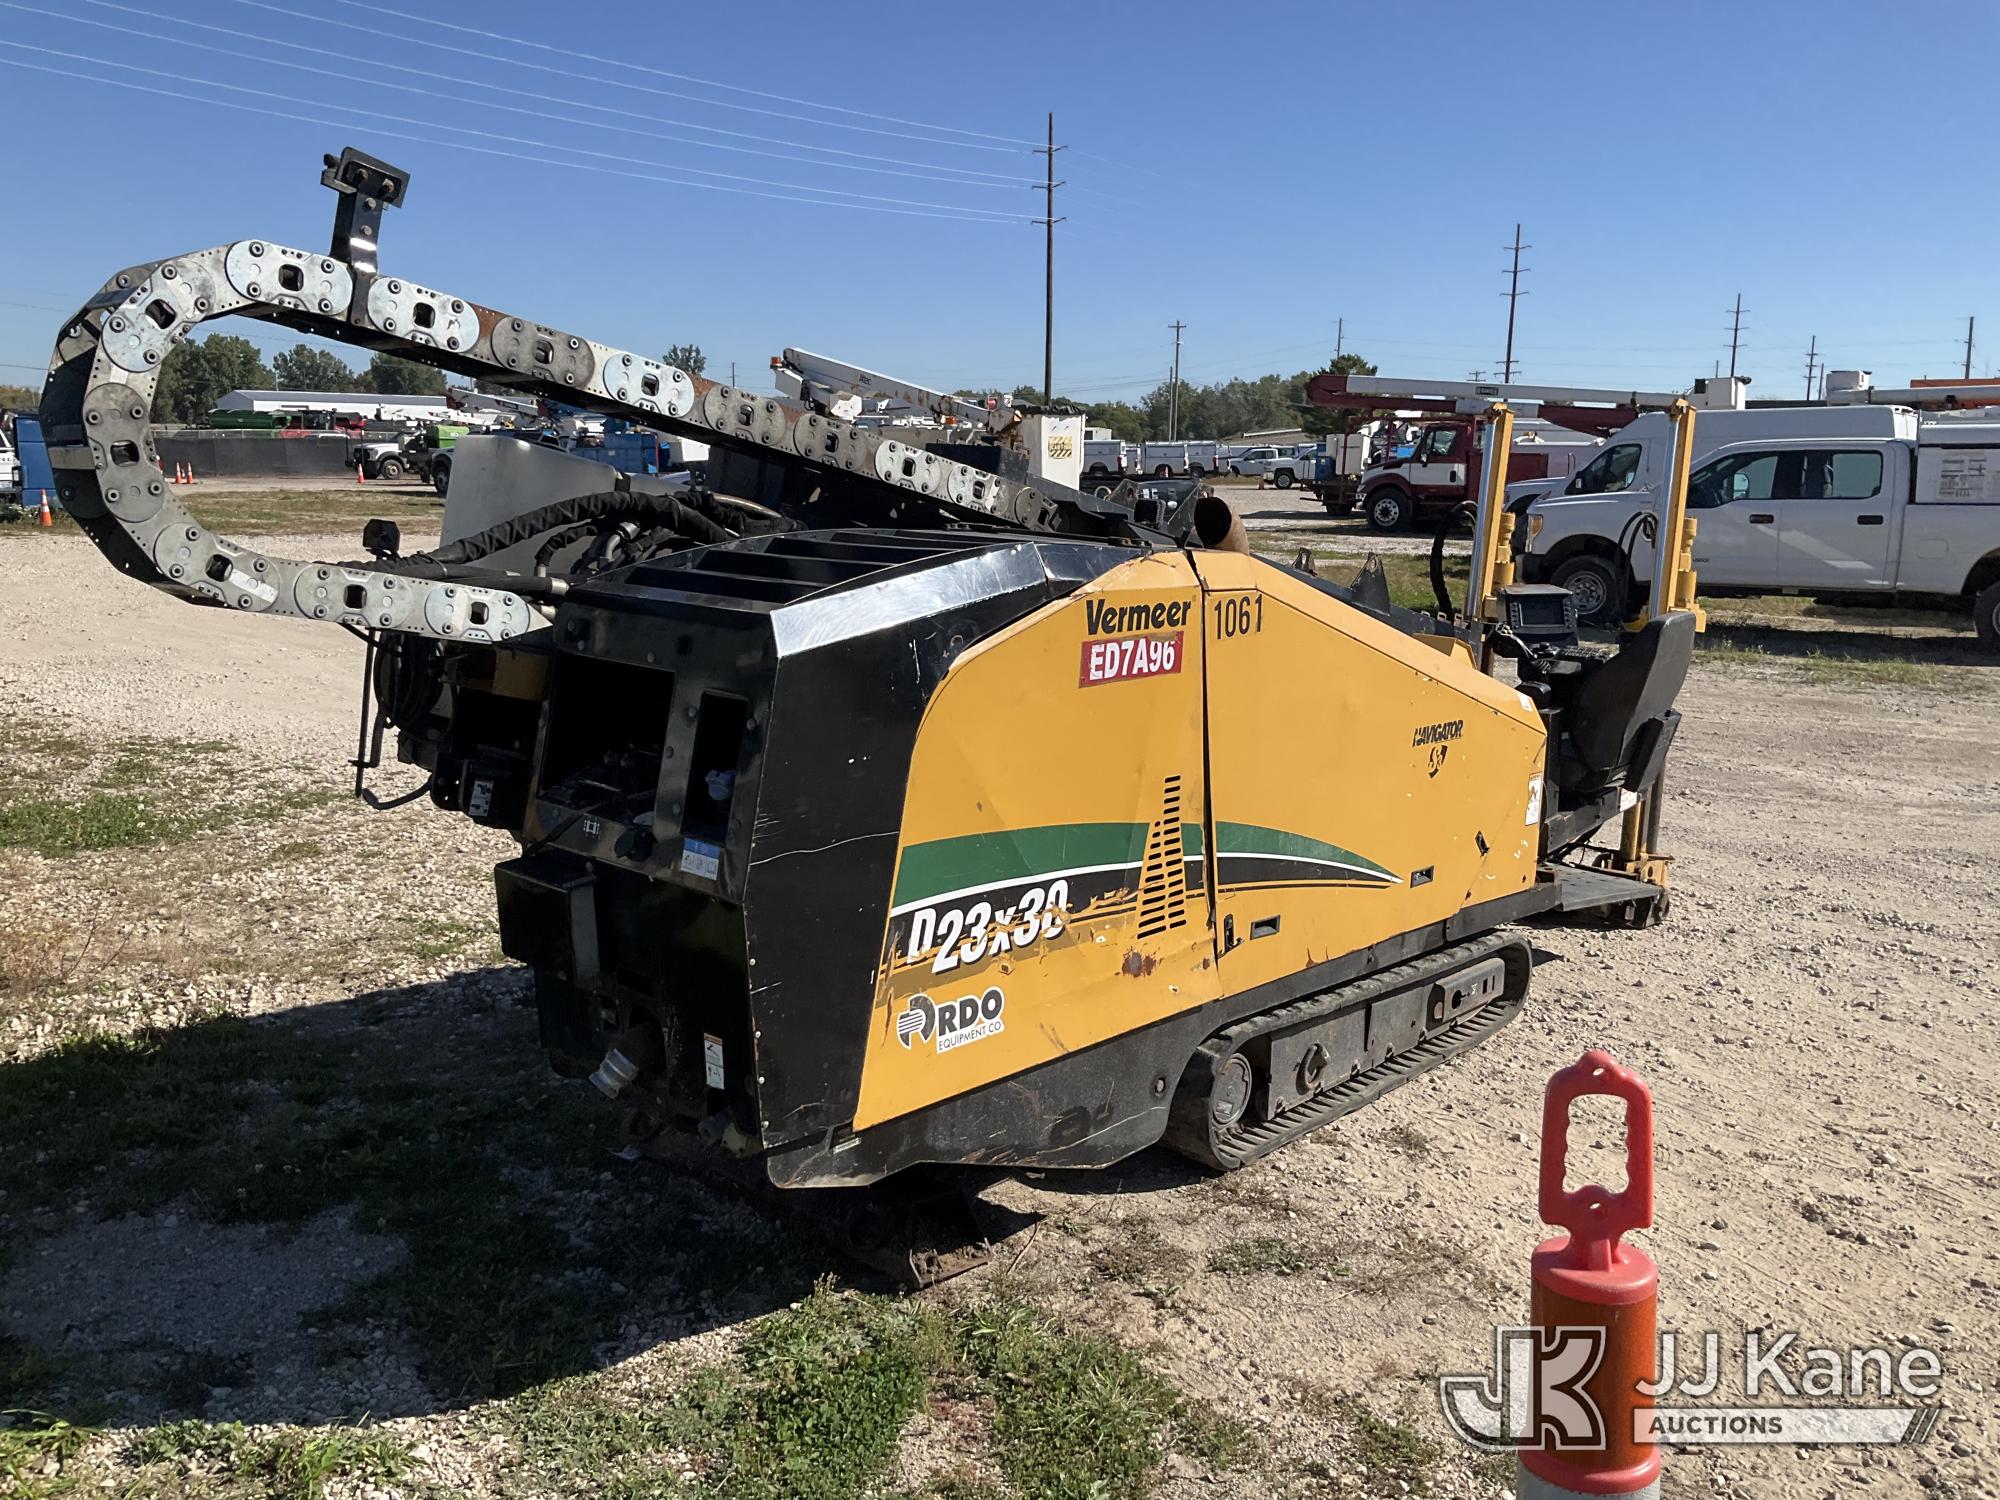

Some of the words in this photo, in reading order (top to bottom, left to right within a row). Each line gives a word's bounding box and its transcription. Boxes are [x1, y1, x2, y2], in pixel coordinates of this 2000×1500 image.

[1086, 599, 1191, 635] Vermeer
[1214, 594, 1263, 639] 1061
[1089, 638, 1176, 681] ED7A96
[1412, 719, 1464, 747] NAVIGATOR
[907, 879, 1069, 974] D23x30
[938, 989, 1003, 1037] RDO
[938, 1025, 986, 1051] EQUIPMENT
[988, 1021, 1002, 1034] CO
